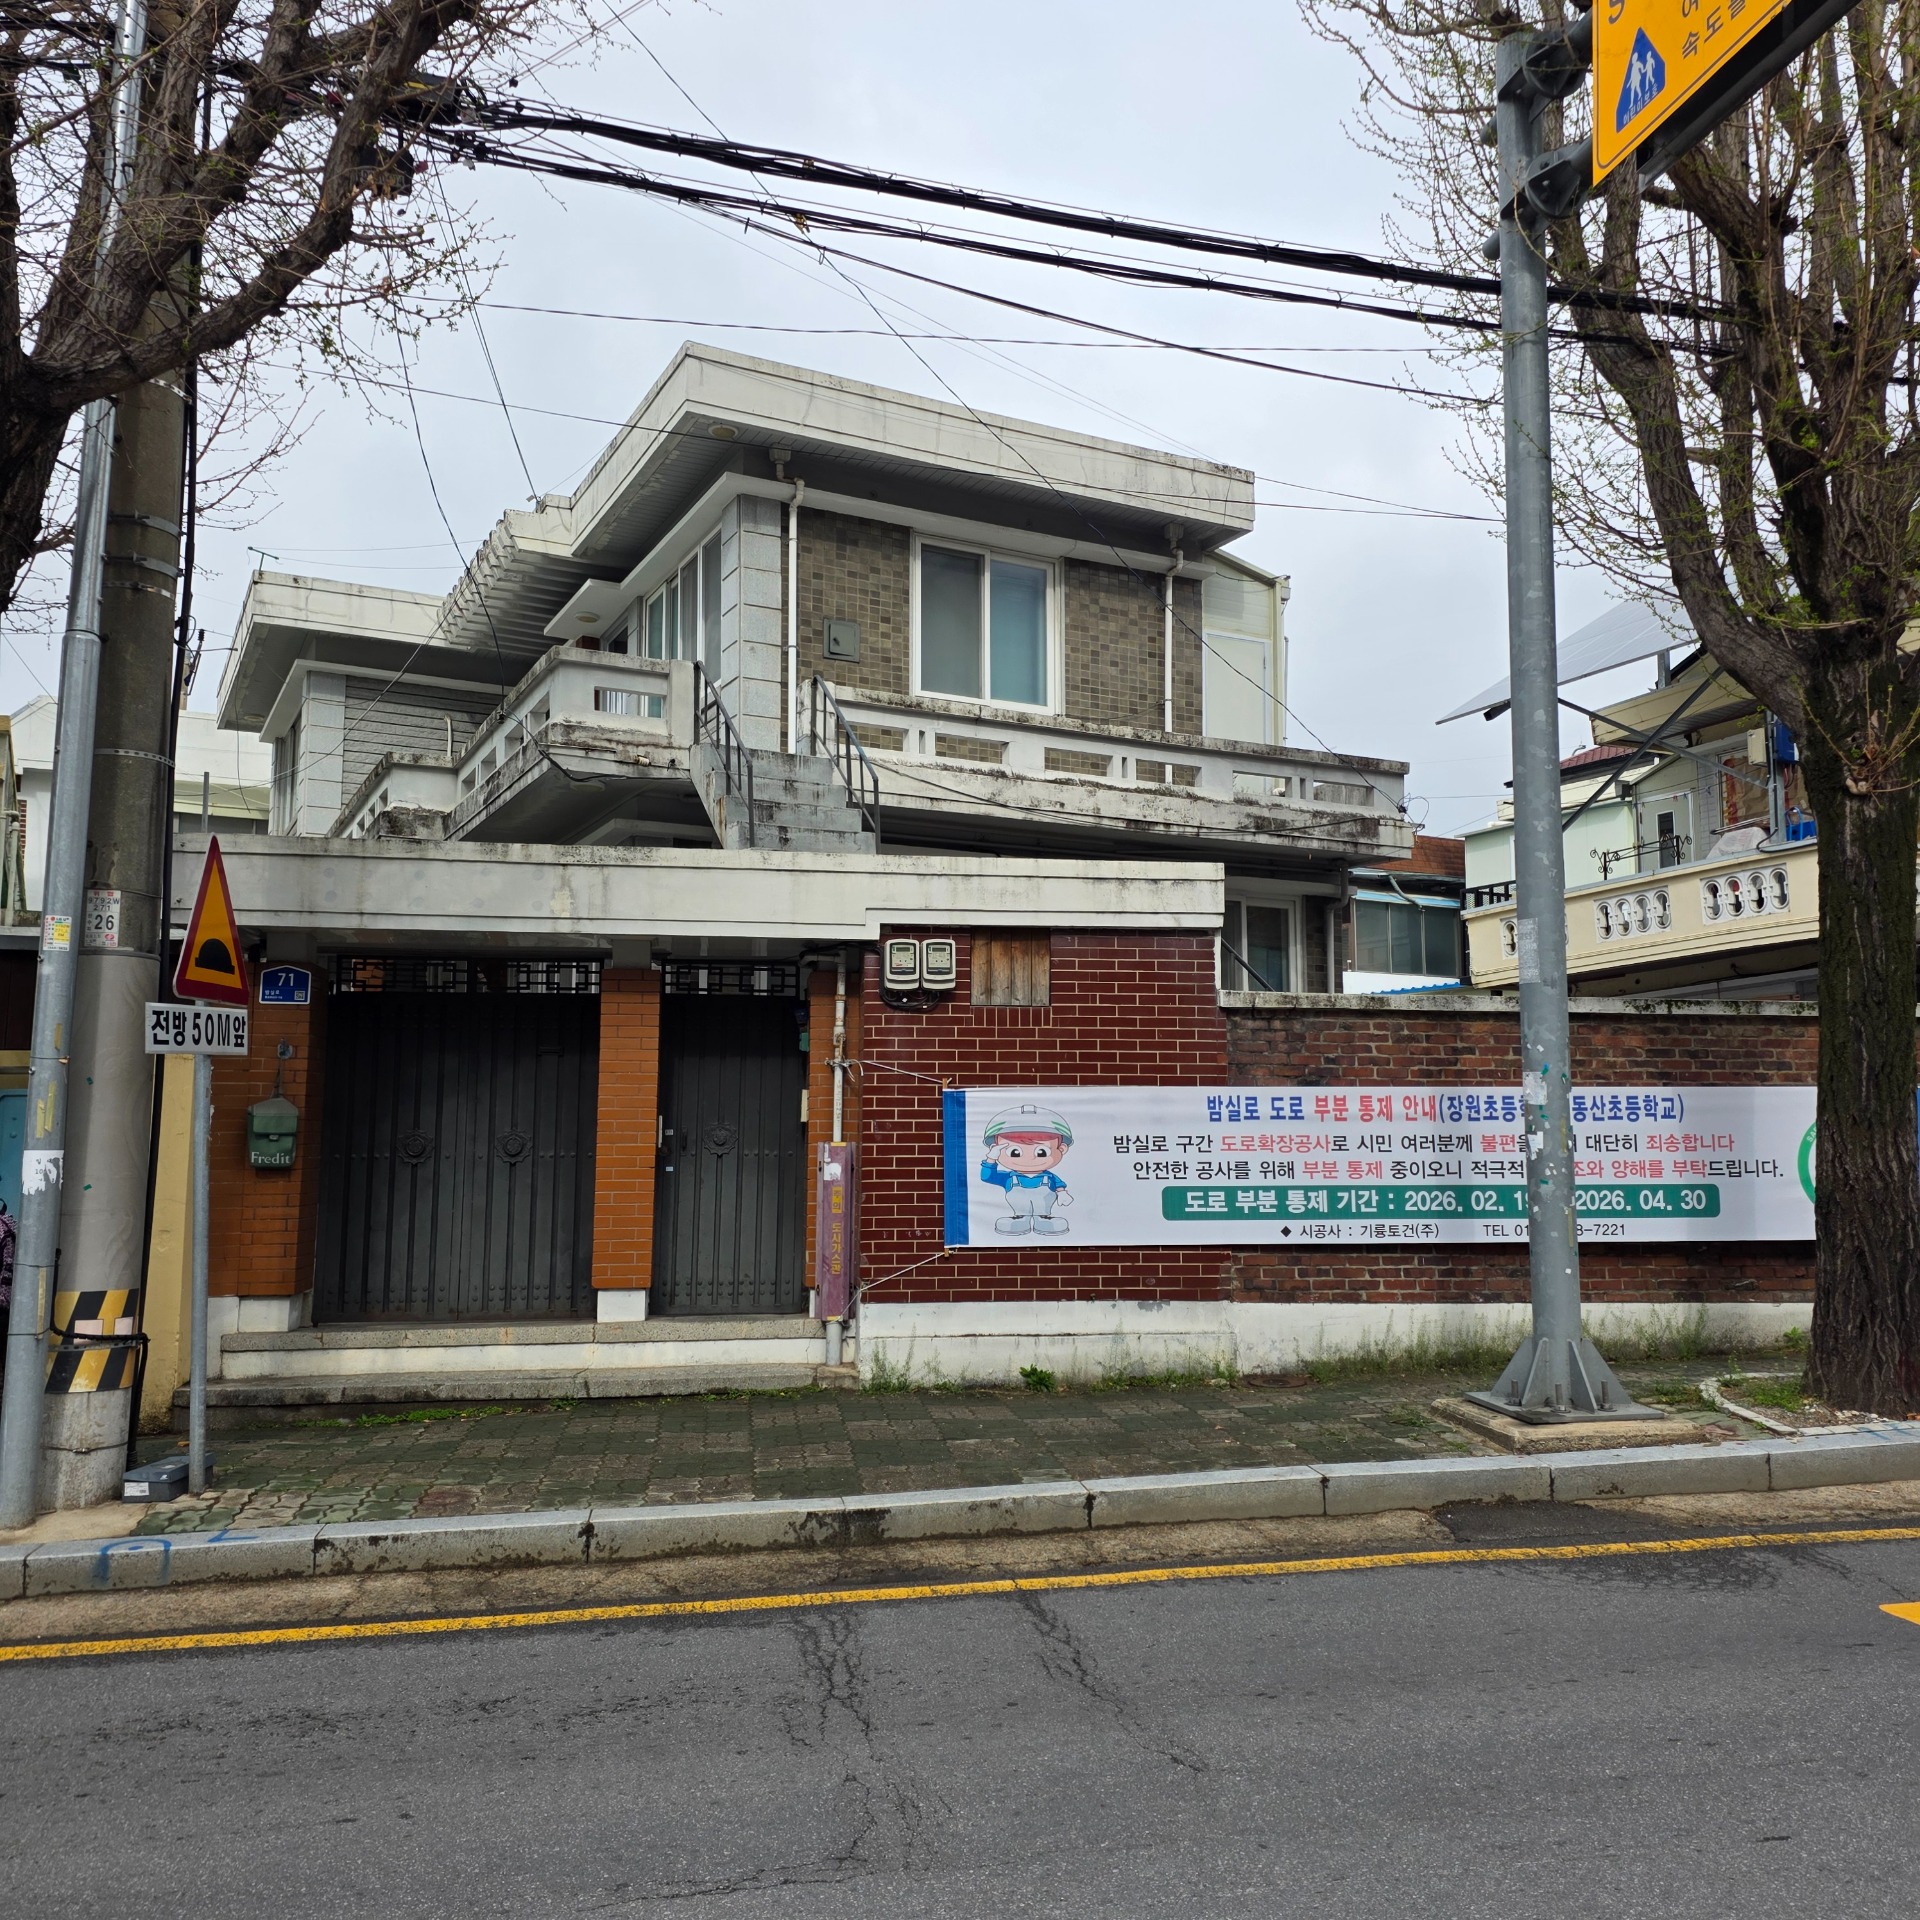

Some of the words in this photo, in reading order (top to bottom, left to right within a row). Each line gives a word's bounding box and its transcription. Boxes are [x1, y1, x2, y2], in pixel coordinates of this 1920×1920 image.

[94, 914, 115, 930] 26
[277, 972, 295, 987] 71
[1206, 1095, 1261, 1122] 밤실로
[1269, 1096, 1305, 1121] 도로
[1314, 1095, 1349, 1122] 부분
[1358, 1095, 1394, 1122] 통제
[1571, 1094, 1685, 1123] 동산초등학교)
[1113, 1134, 1169, 1154] 밤실로
[1176, 1134, 1214, 1153] 구간
[1220, 1134, 1350, 1154] 도로확장공사로
[1357, 1134, 1393, 1153] 시민
[1401, 1134, 1473, 1154] 여러분께
[1586, 1133, 1638, 1153] 대단히
[1646, 1133, 1736, 1153] 죄송합니다
[250, 1151, 291, 1164] Fredit
[1133, 1161, 1189, 1180] 안전한
[1195, 1161, 1251, 1180] 공사를
[1259, 1160, 1295, 1180] 위해
[1302, 1160, 1339, 1180] 부분
[1346, 1160, 1383, 1180] 통제
[1390, 1160, 1463, 1180] 중이오니
[1611, 1159, 1664, 1178] 양해를
[1671, 1158, 1784, 1178] 부탁드립니다.
[1184, 1191, 1228, 1212] 도로
[1235, 1190, 1278, 1213] 부분
[1285, 1190, 1328, 1213] 통제
[1336, 1190, 1379, 1212] 기간
[1404, 1190, 1463, 1212] 2026.
[1471, 1190, 1505, 1212] 02.
[1575, 1190, 1632, 1212] 2026.
[1639, 1190, 1673, 1211] 04.
[1680, 1189, 1706, 1210] 30
[1300, 1223, 1341, 1239] 시공사
[1360, 1223, 1440, 1239] 기륭토건(주)
[1483, 1224, 1510, 1237] TEL
[831, 1222, 842, 1274] 도시가스관
